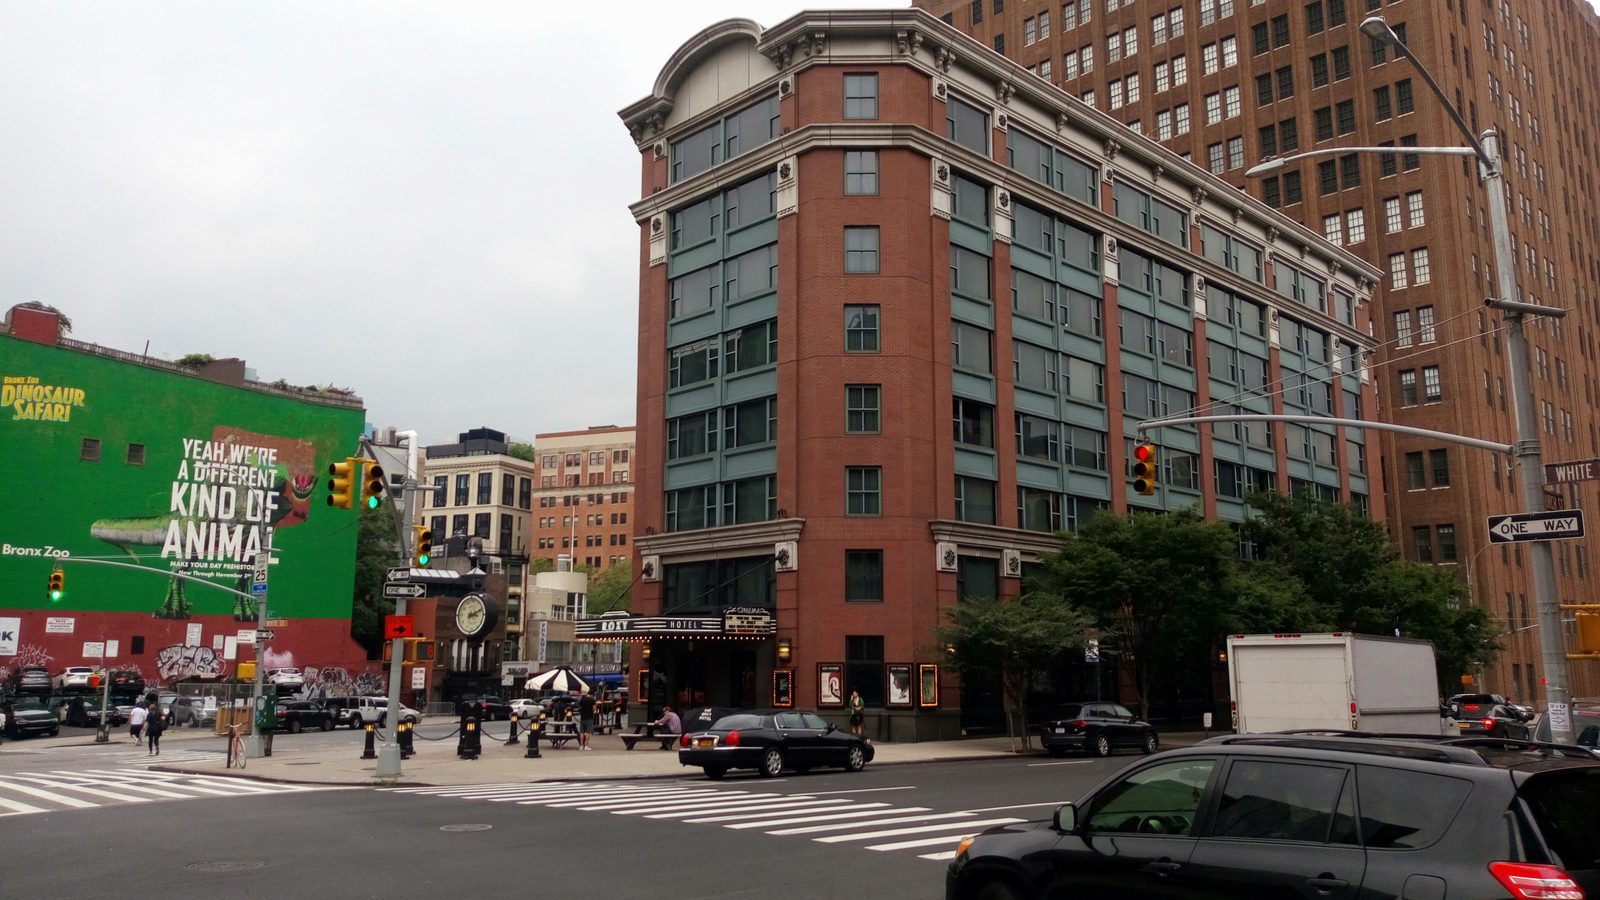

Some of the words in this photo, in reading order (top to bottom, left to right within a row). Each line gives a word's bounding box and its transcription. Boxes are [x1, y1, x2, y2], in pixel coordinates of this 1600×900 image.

[1, 384, 85, 407] DINOSAUR
[12, 398, 71, 422] SAFARI
[183, 438, 228, 464] YEAH,
[230, 443, 277, 467] WE'RE
[177, 459, 189, 480] A
[193, 461, 278, 489] DIFFERENT
[1555, 463, 1594, 482] WHITE
[170, 481, 237, 520] KIND
[246, 489, 280, 523] OF
[1500, 522, 1528, 535] ONE
[1543, 518, 1575, 531] WAY
[2, 543, 43, 557] Bronx
[43, 545, 70, 558] Zoo
[161, 519, 280, 565] ANIMAL
[193, 570, 215, 578] Through
[255, 569, 266, 582] 25
[602, 621, 628, 631] ROXY
[670, 620, 698, 629] HOTEL
